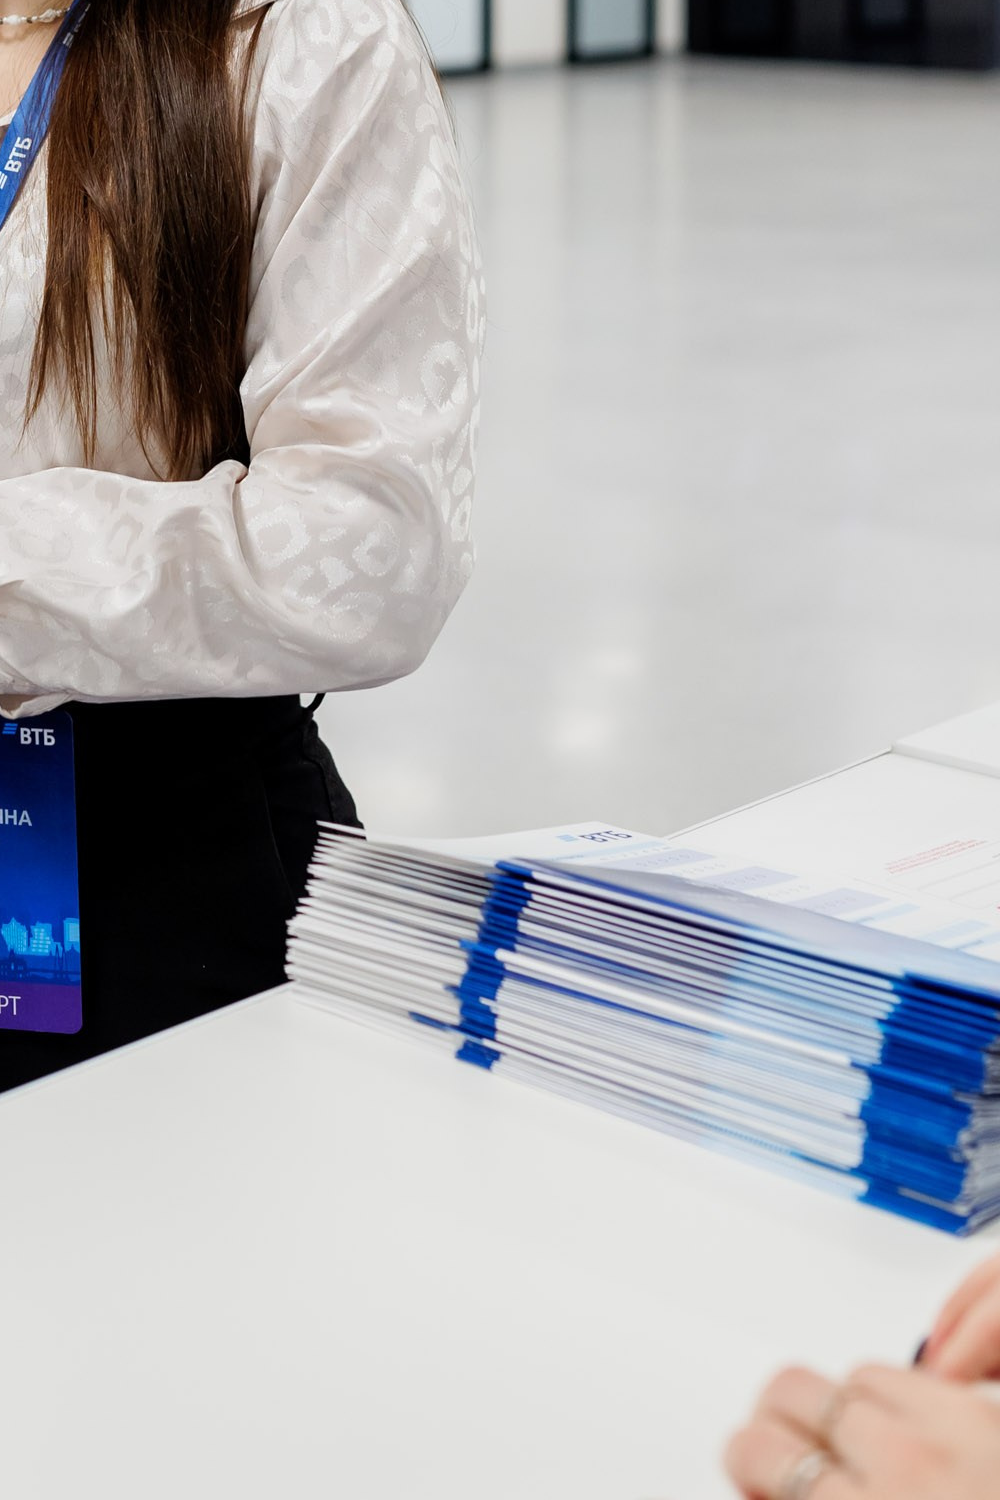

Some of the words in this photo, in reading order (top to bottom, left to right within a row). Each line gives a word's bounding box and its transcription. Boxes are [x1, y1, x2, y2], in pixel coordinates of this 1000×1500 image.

[4, 136, 32, 172] ВТБ
[19, 727, 56, 747] ВТБ
[578, 830, 633, 843] ВТБ
